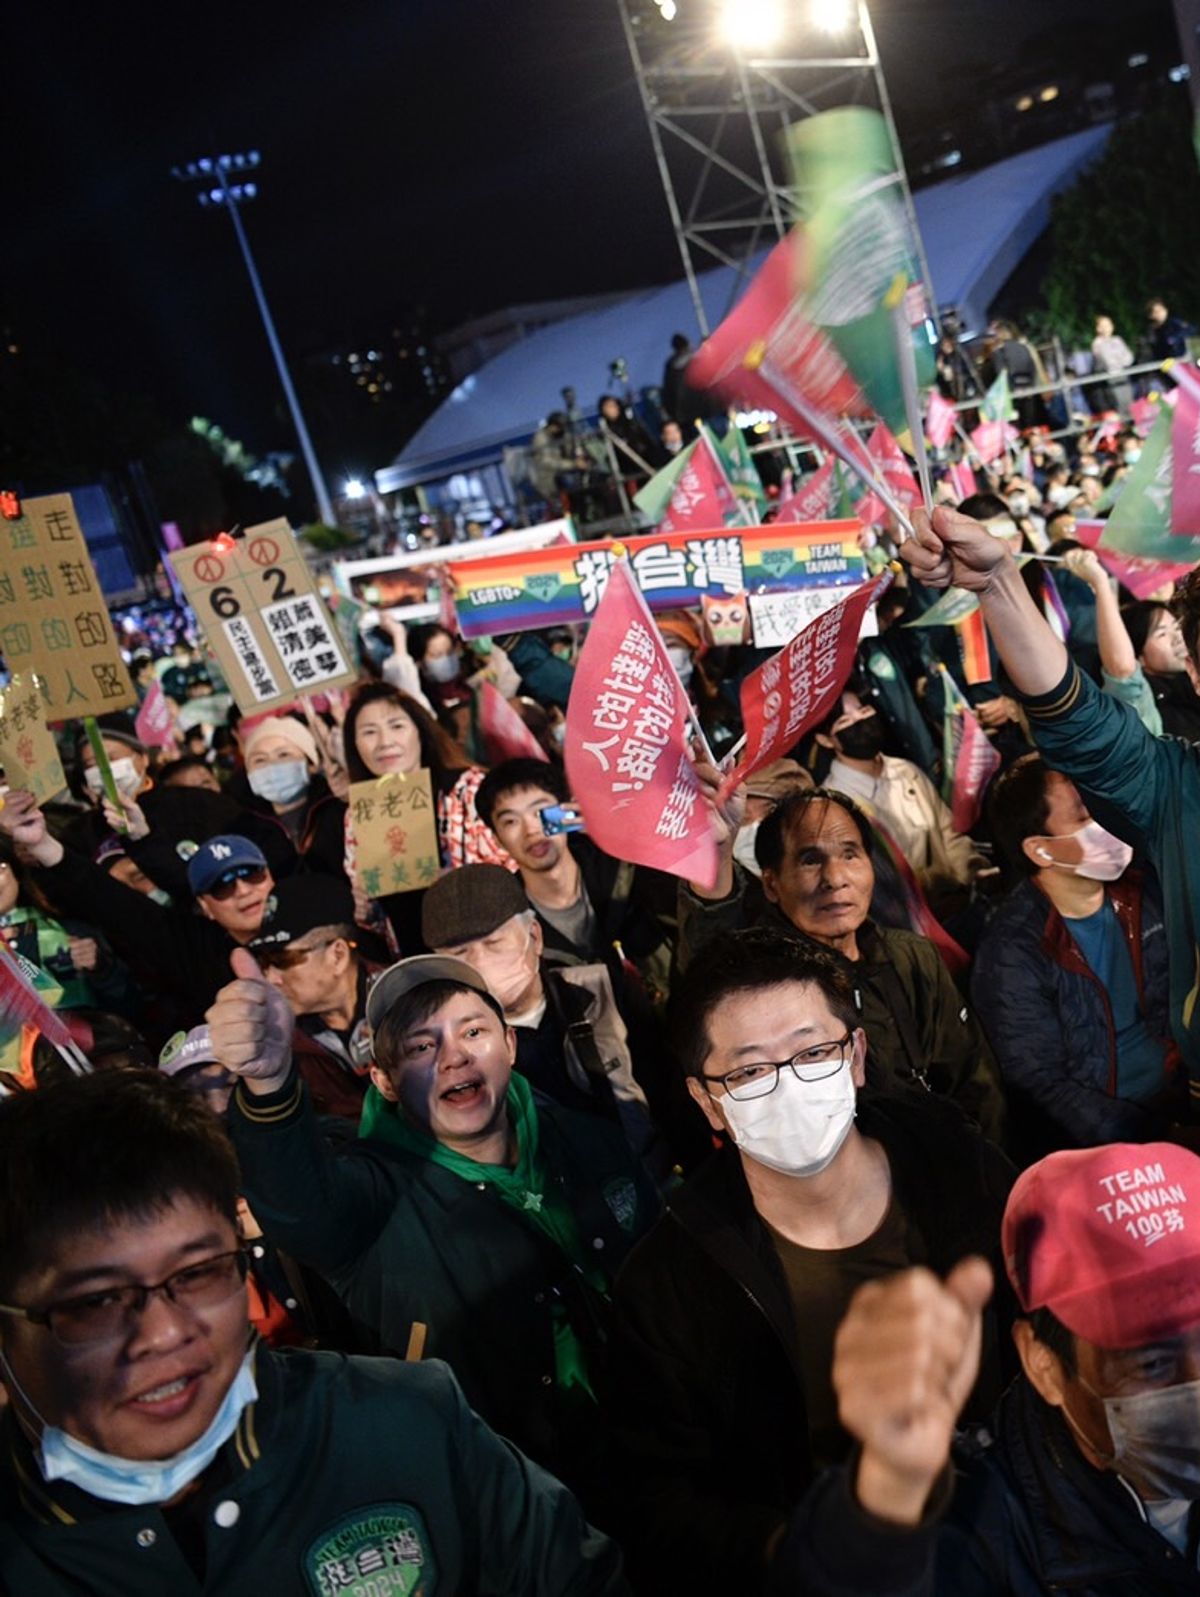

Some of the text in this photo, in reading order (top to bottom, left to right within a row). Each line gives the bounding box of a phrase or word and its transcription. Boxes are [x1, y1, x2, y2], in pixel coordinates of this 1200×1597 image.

[804, 556, 848, 573] TAIWAN
[808, 543, 843, 559] TEAM
[262, 568, 296, 600] 2
[209, 586, 241, 619] 6
[1099, 1162, 1166, 1197] TEAM
[1096, 1184, 1187, 1225] TAIWAN
